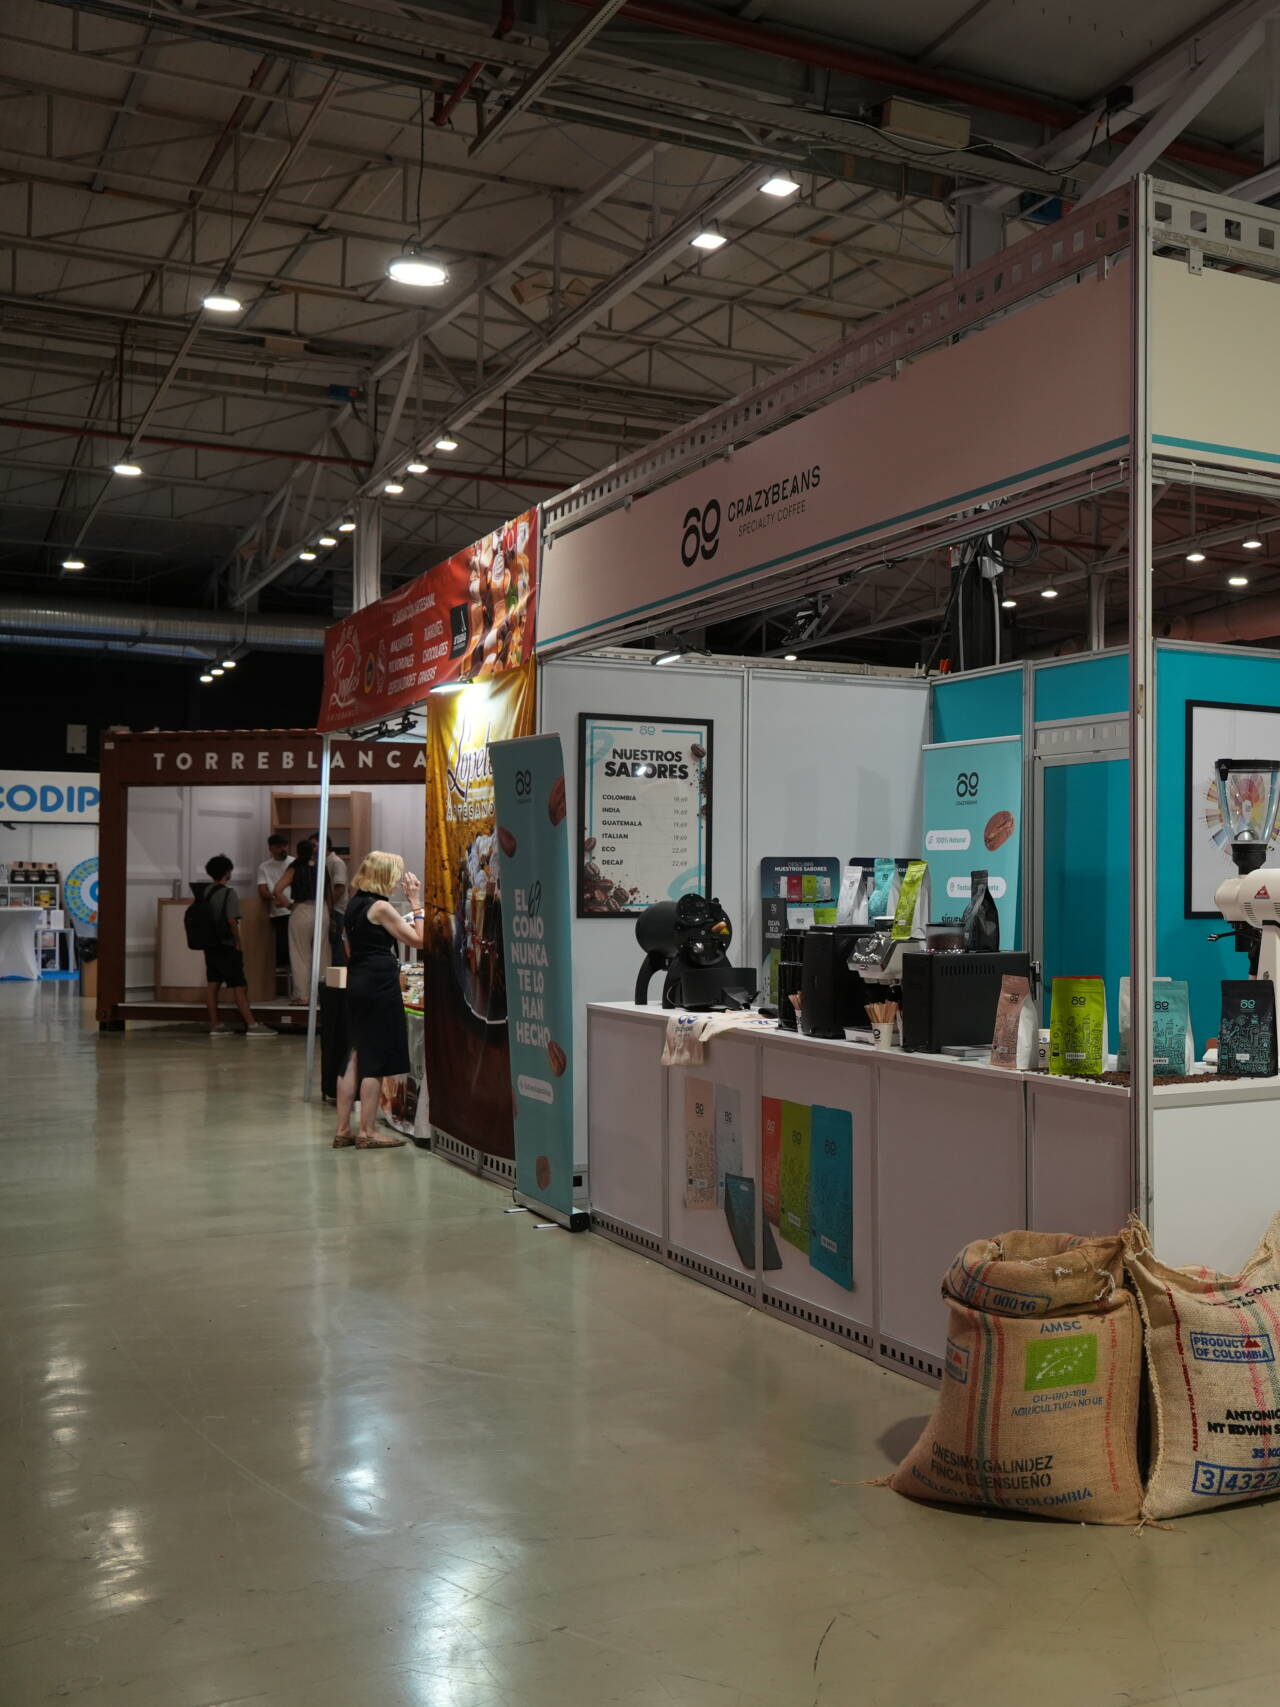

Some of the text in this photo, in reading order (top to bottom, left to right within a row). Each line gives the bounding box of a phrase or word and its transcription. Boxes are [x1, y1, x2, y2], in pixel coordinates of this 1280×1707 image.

[728, 465, 821, 522] CRAZYBEANS
[737, 500, 806, 537] SPECIALTY COFFEE
[153, 751, 427, 770] TORREBLANCA
[612, 748, 682, 762] NUESTROS
[604, 761, 689, 780] SABORES
[0, 784, 100, 813] ODIP
[514, 889, 528, 911] EL
[512, 916, 544, 940] COMO
[510, 942, 549, 967] NUNCA
[517, 969, 544, 994] TE LO
[522, 997, 544, 1019] HAN
[516, 1021, 550, 1049] HECHO
[1040, 1320, 1082, 1334] AMSC
[1193, 1336, 1246, 1348] PRODUCT
[1195, 1347, 1269, 1359] OF COLOMBIA
[1207, 1421, 1225, 1434] NT
[1228, 1422, 1272, 1435] EDWIN
[932, 1440, 1054, 1474] ONESIMO GALINDEZ
[930, 1459, 963, 1485] FINCA
[986, 1471, 1051, 1490] ENSUEÑO
[1200, 1469, 1215, 1490] 3
[1225, 1471, 1277, 1491] 4322
[1015, 1487, 1093, 1506] COLOMBIA
